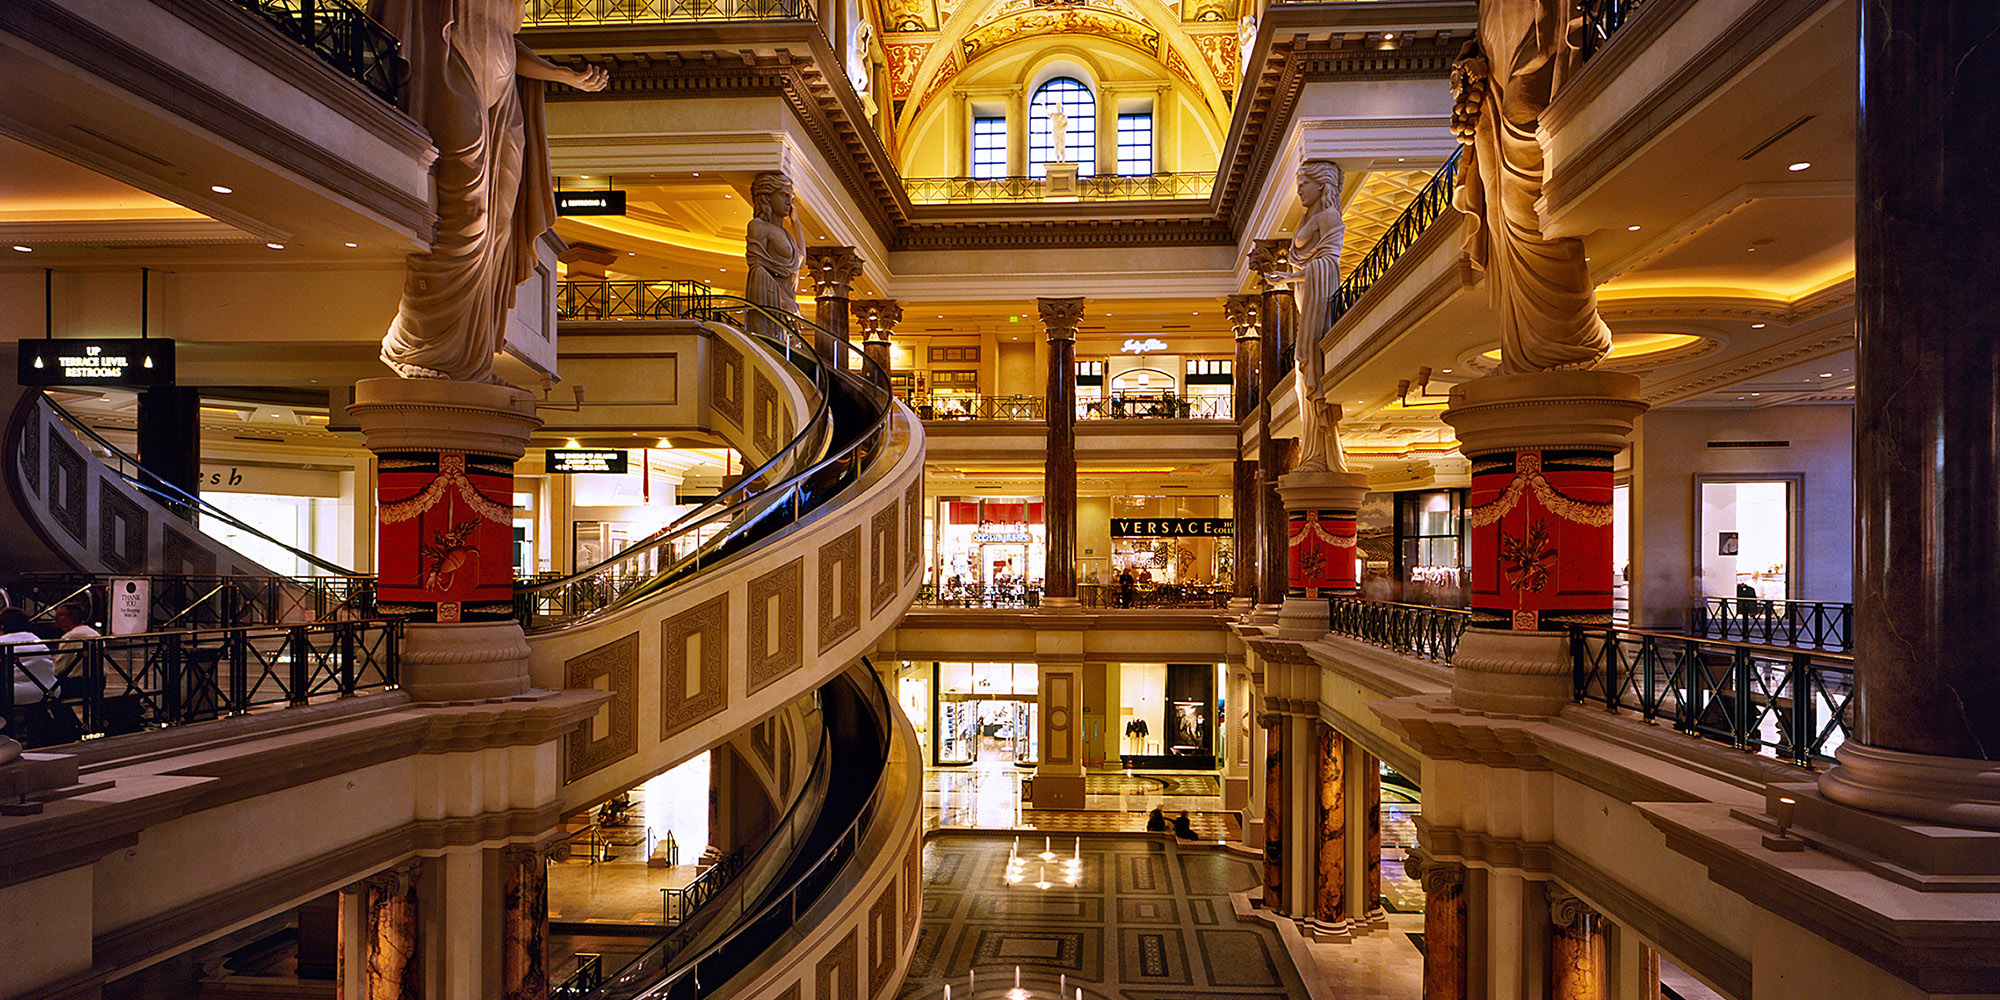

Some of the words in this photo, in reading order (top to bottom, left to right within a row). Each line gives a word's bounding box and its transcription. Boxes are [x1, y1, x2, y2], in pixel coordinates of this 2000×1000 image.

[86, 346, 101, 356] UP
[58, 356, 100, 367] TERRACE
[100, 356, 128, 367] LEVEL
[65, 367, 122, 377] RESTROOMS
[1120, 521, 1212, 534] VERSACE
